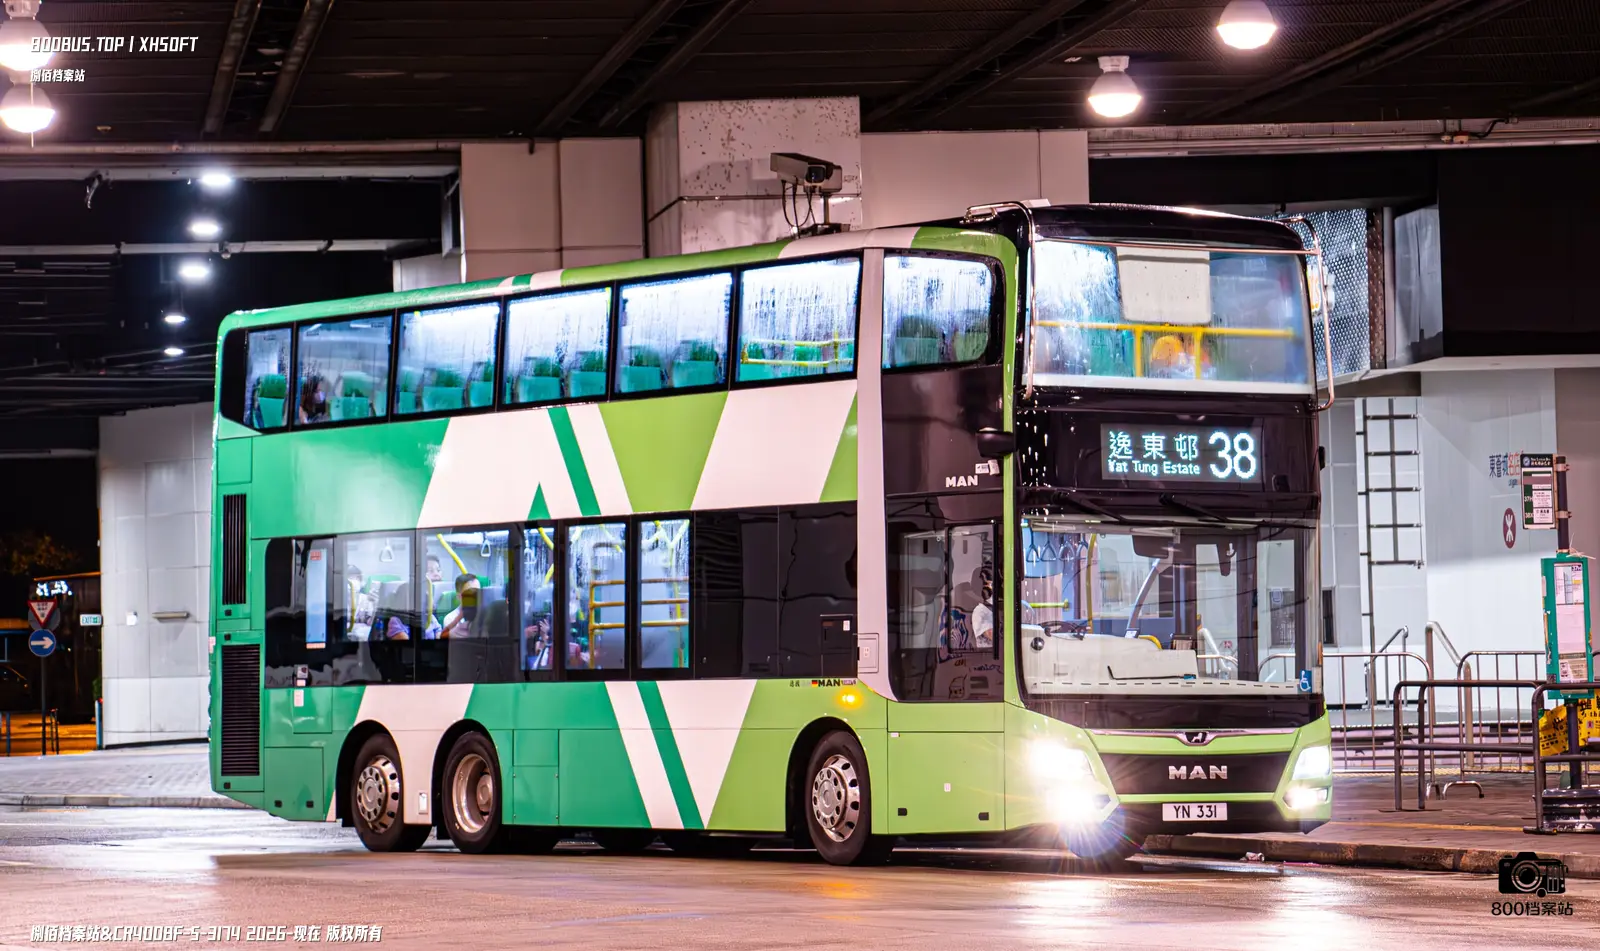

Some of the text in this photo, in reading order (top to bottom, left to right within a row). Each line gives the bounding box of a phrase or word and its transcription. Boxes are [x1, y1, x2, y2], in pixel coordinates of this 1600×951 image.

[1109, 431, 1198, 461] 逸東邨
[1209, 431, 1257, 479] 38
[1108, 460, 1200, 475] Yat Tung Estate
[945, 475, 979, 488] MAN
[818, 679, 841, 687] MAN
[1168, 765, 1228, 780] MAN
[1173, 804, 1217, 818] YN 331
